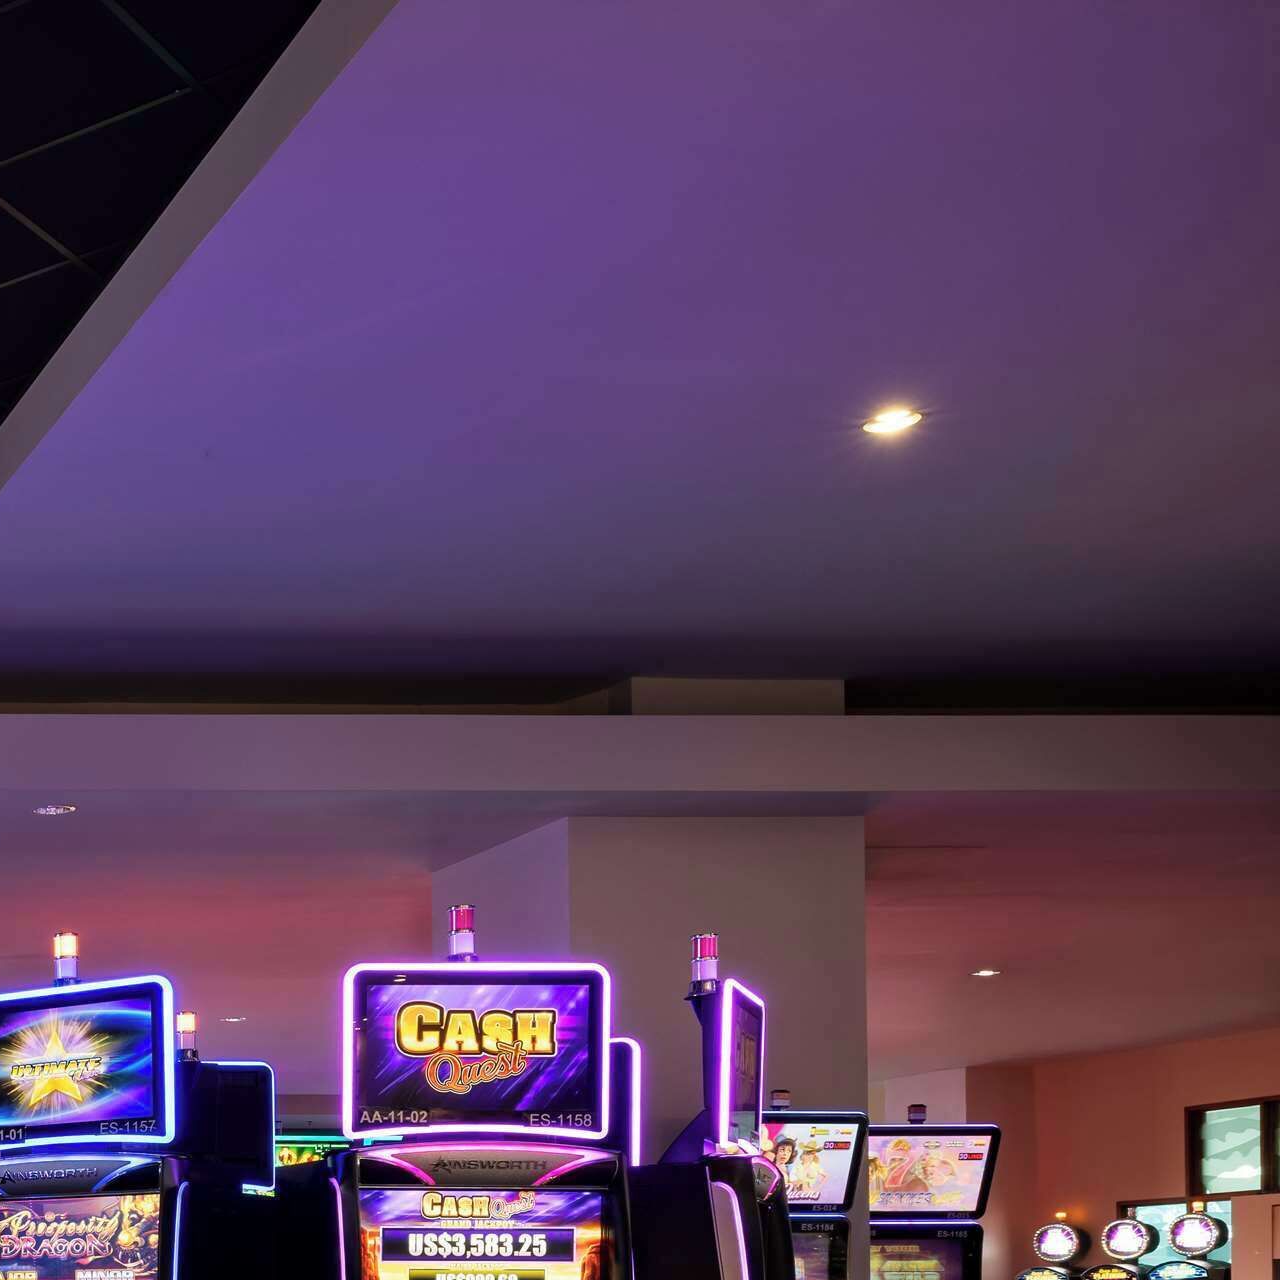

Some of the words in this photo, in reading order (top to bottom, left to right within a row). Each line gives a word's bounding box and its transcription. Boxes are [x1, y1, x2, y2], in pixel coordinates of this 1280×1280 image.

[395, 1001, 557, 1057] CASH
[10, 1056, 103, 1080] ULTIMATE
[426, 1040, 527, 1094] Quest
[99, 1119, 156, 1135] ES-1157
[360, 1110, 428, 1124] AA-11-02
[529, 1113, 592, 1127] ES-1158
[0, 1167, 97, 1184] AINSWORTH
[429, 1156, 547, 1173] AINSWORTH
[422, 1192, 490, 1219] CASH
[490, 1191, 535, 1219] Quest
[1, 1233, 114, 1258] DRAGON
[408, 1231, 547, 1259] US$3,583.25
